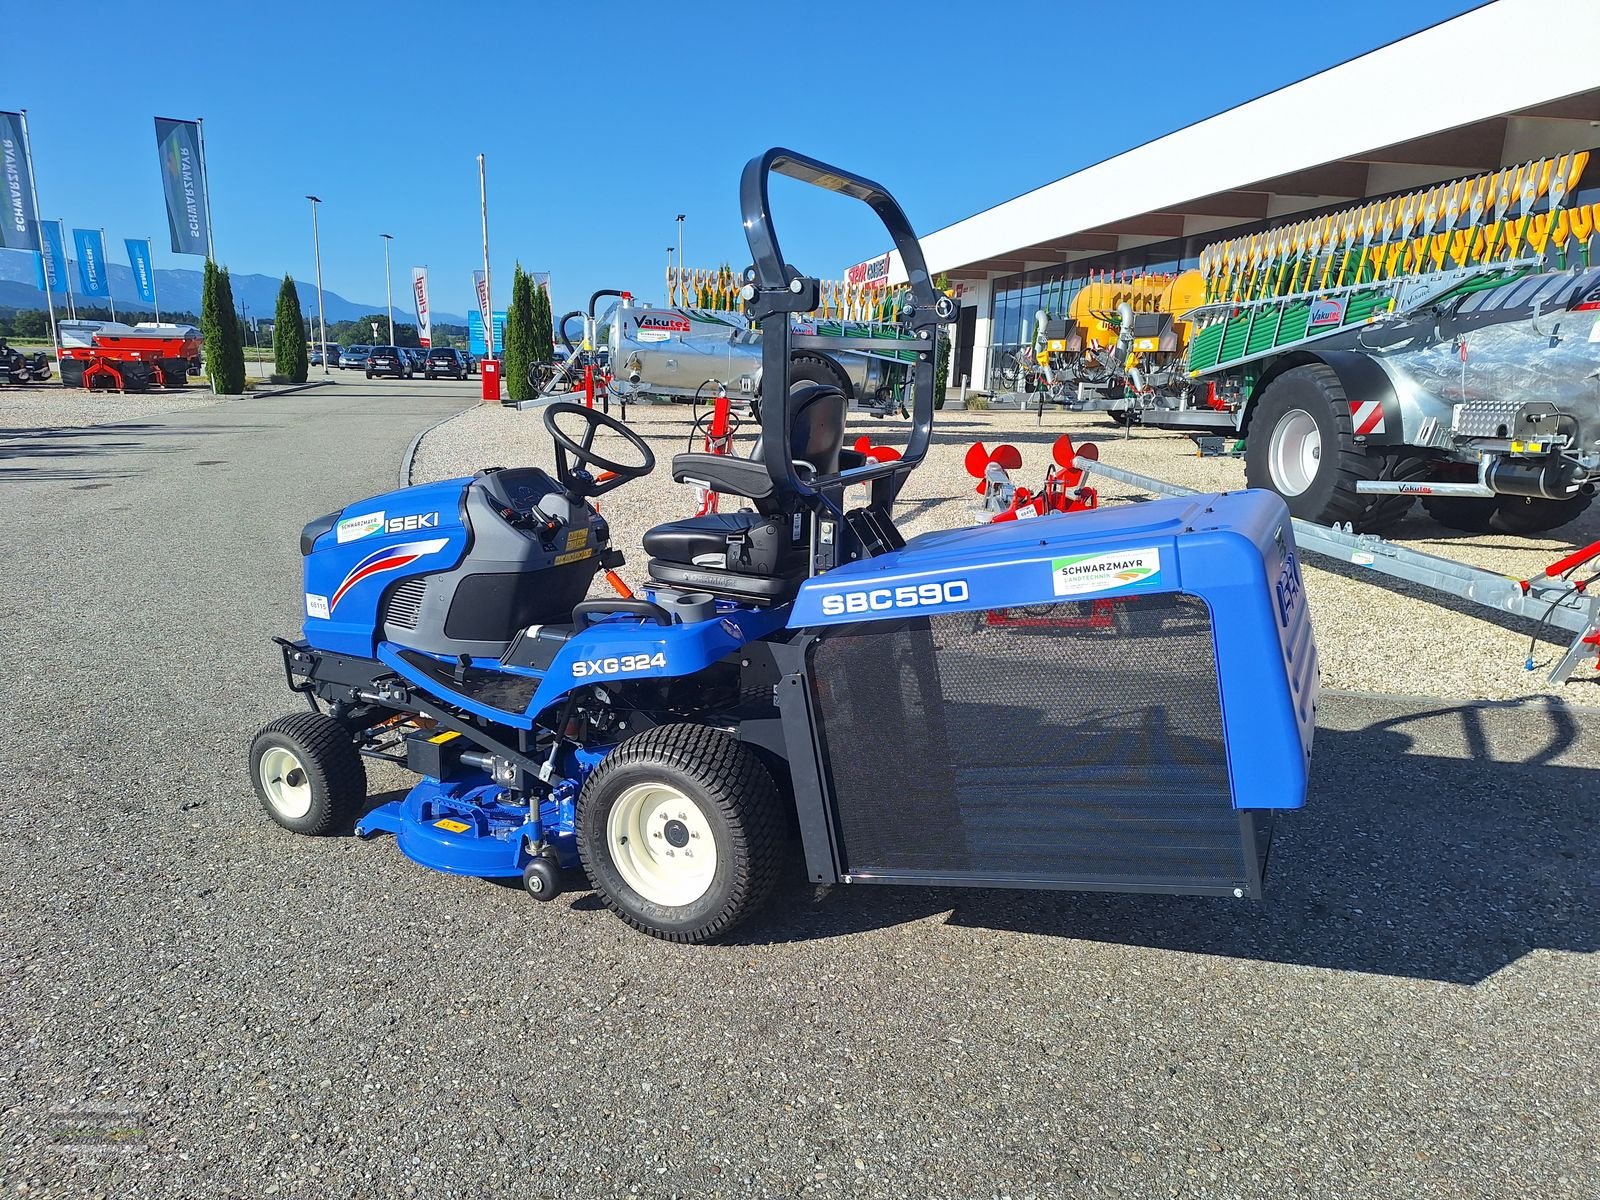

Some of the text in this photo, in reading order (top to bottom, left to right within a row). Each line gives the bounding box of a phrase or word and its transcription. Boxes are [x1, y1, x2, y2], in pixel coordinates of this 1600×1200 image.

[634, 314, 691, 331] Vakutec
[1312, 309, 1340, 321] Vakutec
[1398, 484, 1432, 493] Vakutec
[384, 512, 439, 534] ISEKI
[1062, 559, 1143, 576] SCHWARZMAYR
[1064, 573, 1111, 583] LANDTECHNIK
[822, 580, 969, 616] SBC590
[572, 652, 667, 677] SXG324
